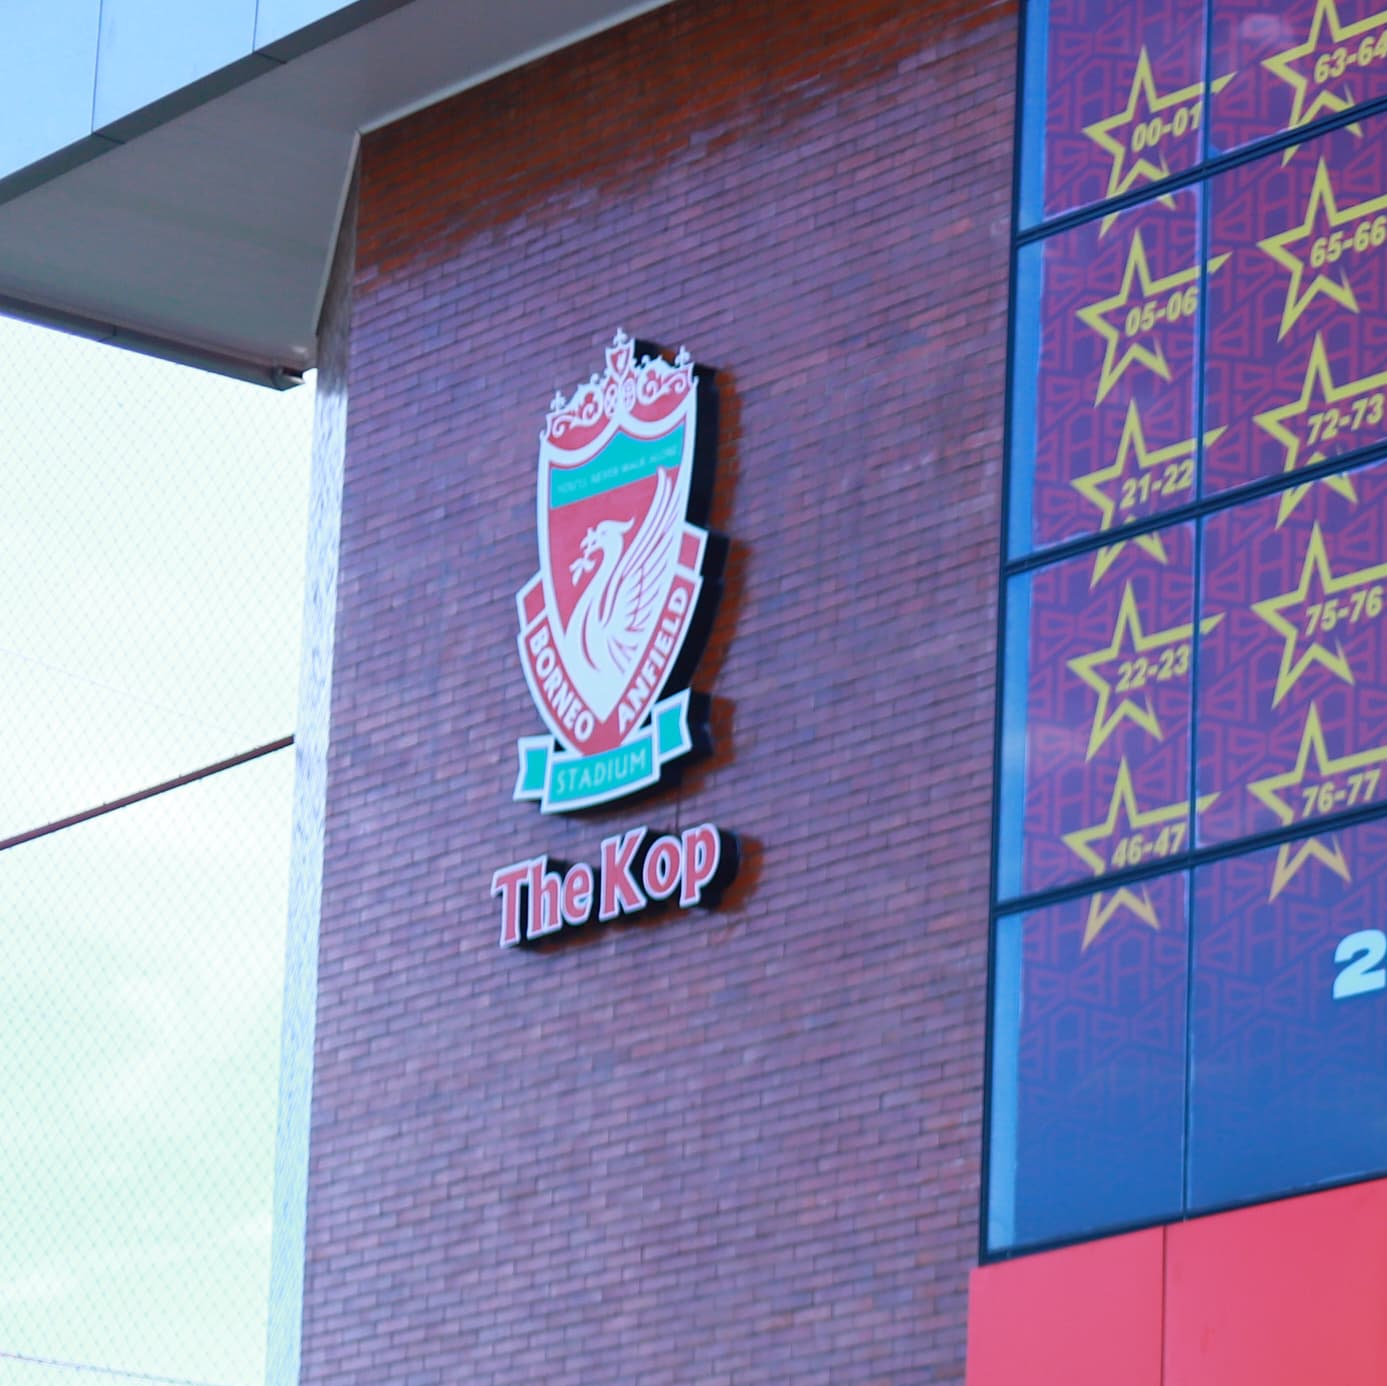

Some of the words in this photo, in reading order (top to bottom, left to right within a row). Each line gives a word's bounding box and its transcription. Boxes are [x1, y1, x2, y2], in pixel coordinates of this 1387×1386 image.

[1131, 99, 1202, 153] 00-01
[1310, 214, 1387, 268] 65-66
[1124, 286, 1198, 337] 05-06
[1307, 392, 1386, 446] 72-73
[1119, 458, 1194, 510] 21-22
[1304, 585, 1383, 637] 75-76
[529, 625, 595, 742] BORNEO
[617, 586, 689, 736] ANFIELD
[1114, 643, 1190, 694] 22-23
[556, 748, 647, 795] STADIUM
[1302, 768, 1380, 818] 76-77
[1111, 821, 1186, 869] 46-47
[490, 854, 594, 949] The
[598, 823, 721, 922] Kop
